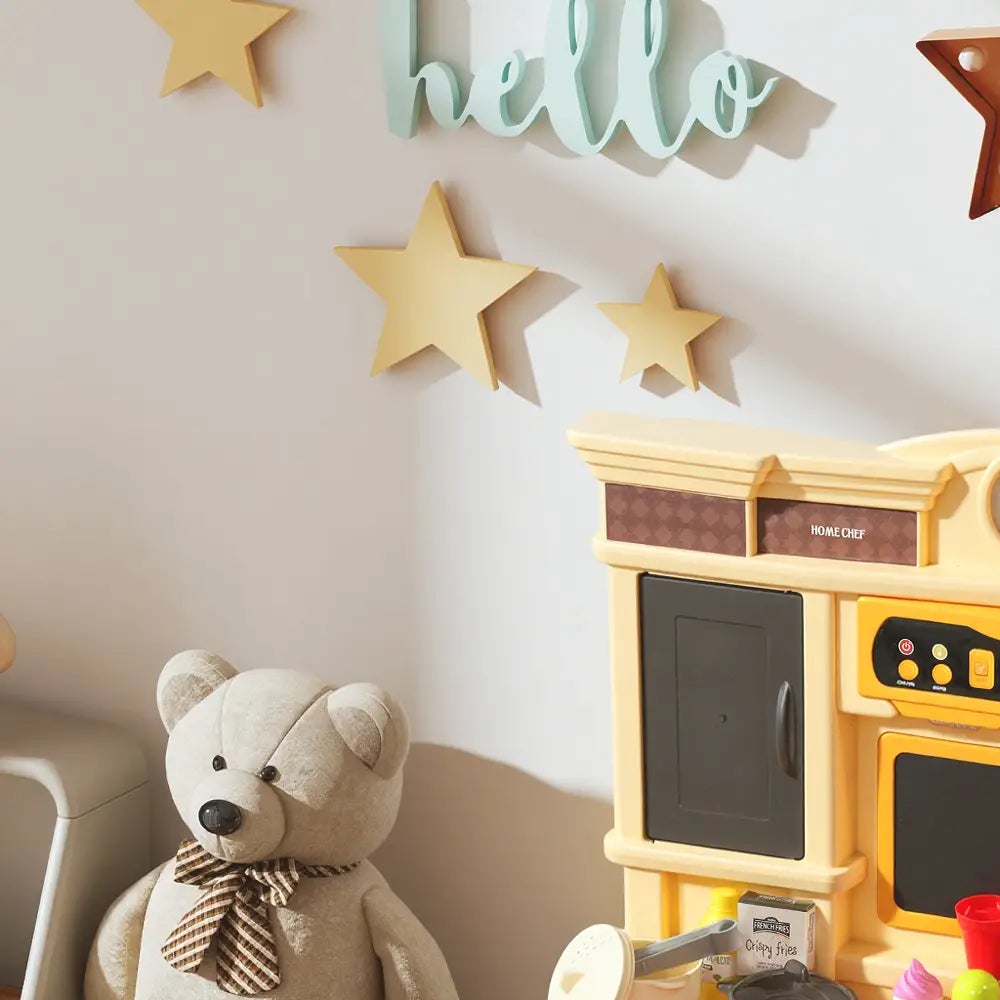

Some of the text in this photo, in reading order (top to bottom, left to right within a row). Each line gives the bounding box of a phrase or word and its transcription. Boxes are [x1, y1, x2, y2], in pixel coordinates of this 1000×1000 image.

[381, 0, 780, 159] hello
[811, 525, 866, 540] HOME CHEF
[745, 939, 797, 959] Crispy fries
